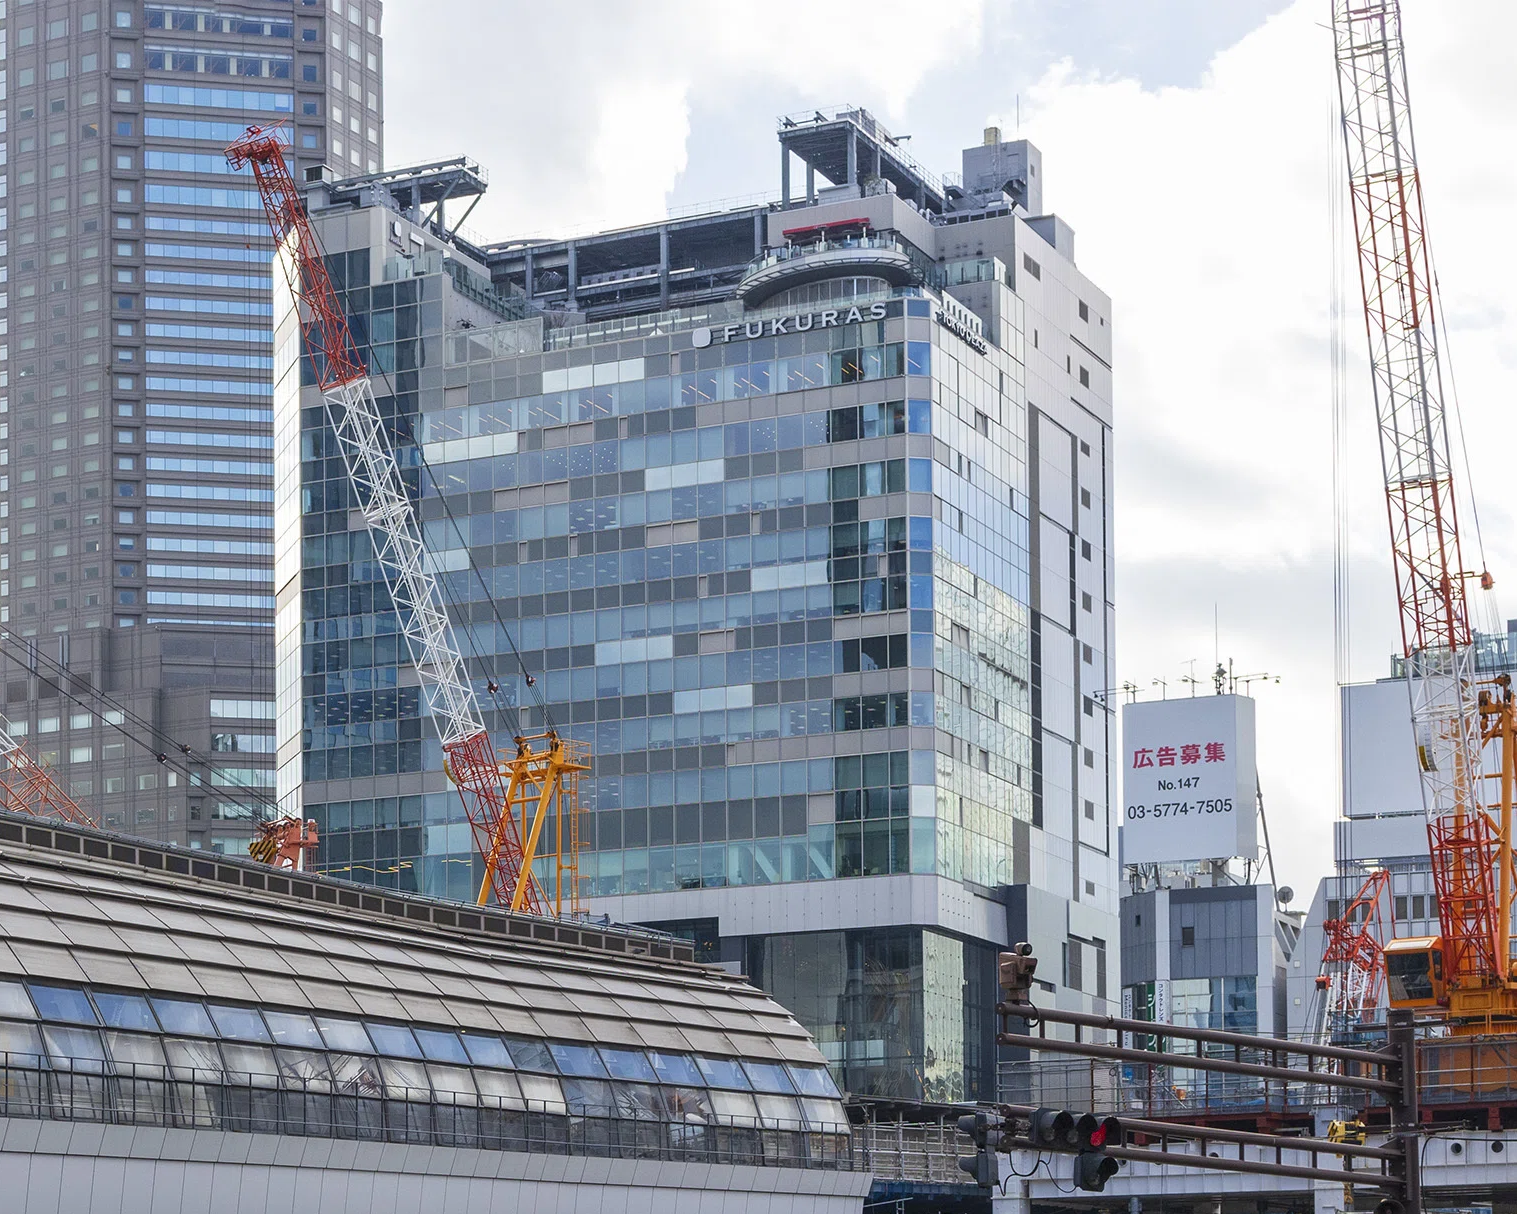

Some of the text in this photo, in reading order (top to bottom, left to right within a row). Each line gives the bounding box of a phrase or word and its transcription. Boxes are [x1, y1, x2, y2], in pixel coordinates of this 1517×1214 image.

[724, 302, 887, 343] FUKURAS
[1132, 742, 1226, 769] 広告募集
[1158, 777, 1200, 791] No.147
[1127, 798, 1233, 820] 03-5774-7505
